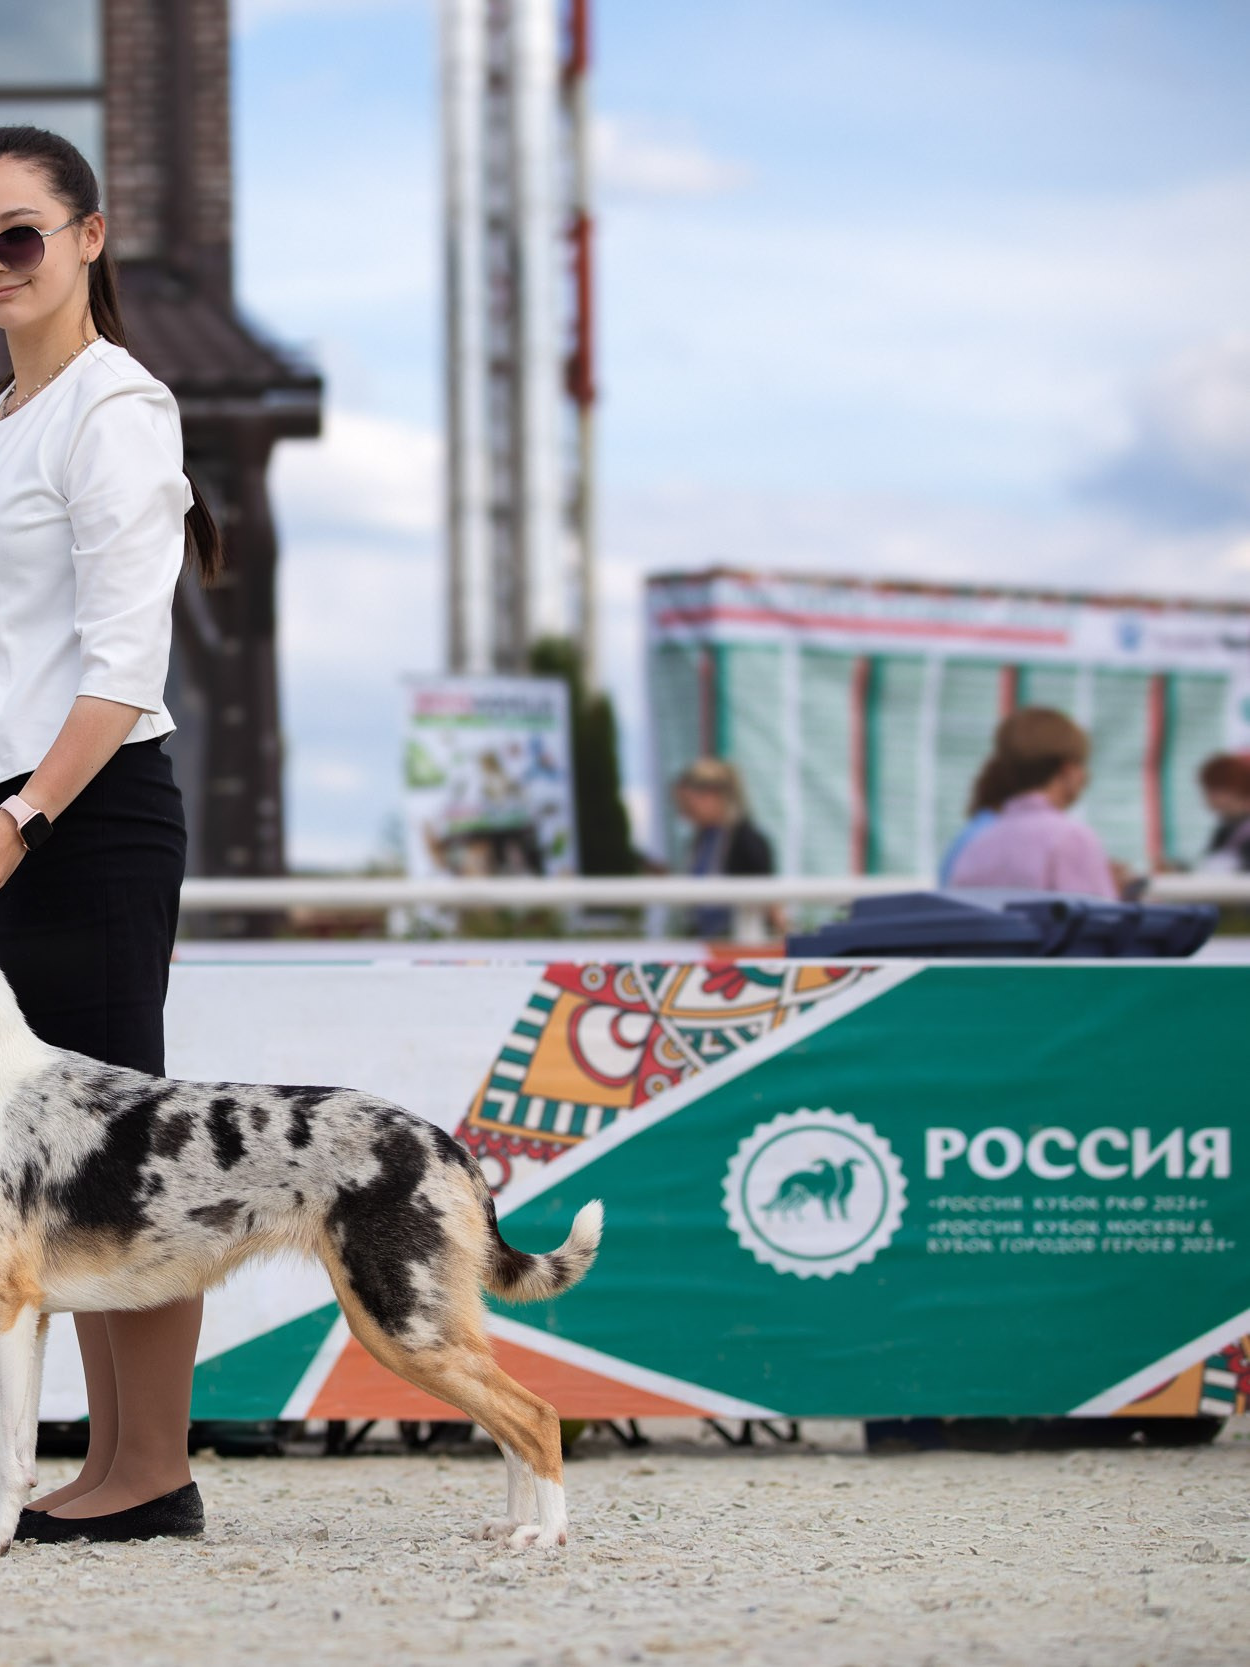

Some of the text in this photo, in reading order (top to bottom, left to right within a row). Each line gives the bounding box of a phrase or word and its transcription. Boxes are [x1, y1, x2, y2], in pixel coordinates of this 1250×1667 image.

[926, 1126, 1231, 1180] РОССИЯ
[1033, 1195, 1100, 1212] КУБОК
[1033, 1219, 1100, 1235] КУБОК
[1106, 1219, 1195, 1235] МОСКВЫ
